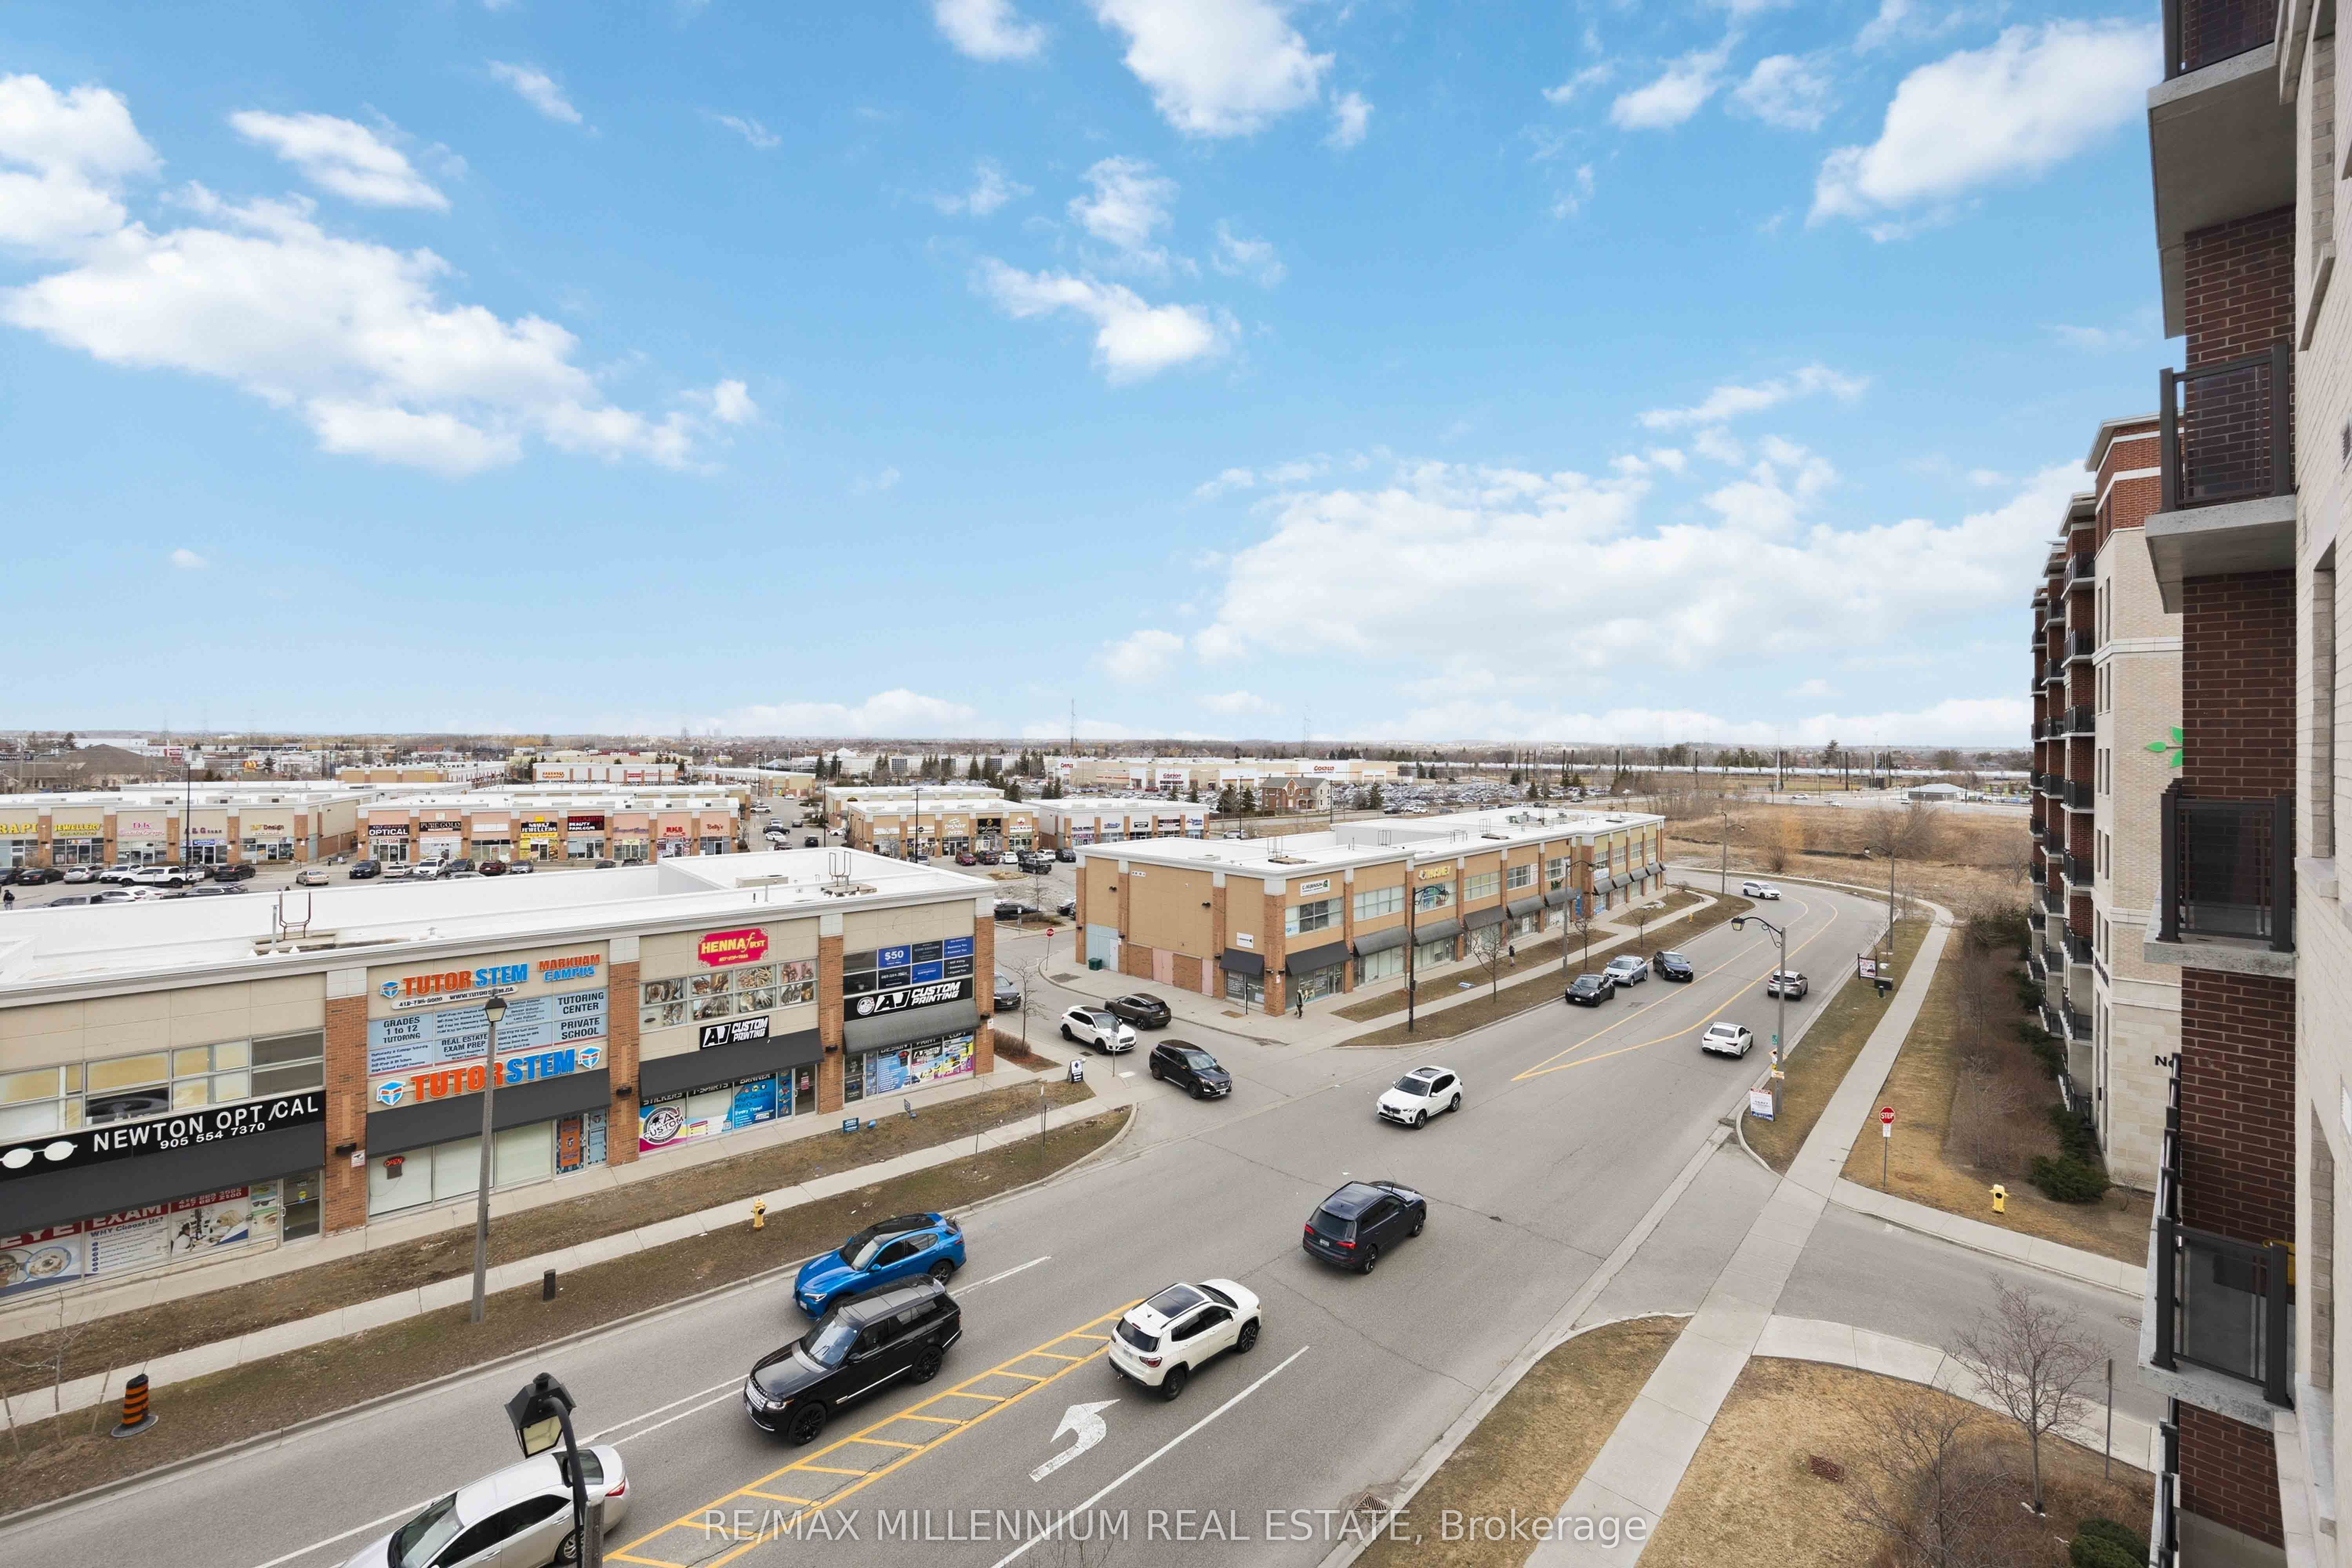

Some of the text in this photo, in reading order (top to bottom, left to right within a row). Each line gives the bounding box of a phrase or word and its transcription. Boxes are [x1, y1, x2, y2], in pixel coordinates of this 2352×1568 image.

[701, 938, 745, 954] HENNA
[539, 954, 600, 971] MARKHAM
[884, 950, 904, 960] $50
[544, 965, 595, 982] CAMPUS
[557, 992, 604, 1005] TUTORING
[875, 981, 961, 1012] AJ CUSTOM
[911, 990, 959, 1006] PRINTING
[563, 1002, 599, 1014] CENTER
[383, 1016, 420, 1027] GRADES
[561, 1017, 600, 1030] PRIVATE
[383, 1033, 420, 1044] TUTORING
[462, 1033, 488, 1042] ESTATE
[561, 1027, 599, 1040] SCHOOL
[703, 1017, 769, 1047] AJ CUSTOM
[733, 1028, 766, 1042] PRINTING
[443, 1040, 486, 1053] EXAM PREP
[94, 1096, 318, 1152] NEWTON OPTICAL
[643, 1116, 684, 1140] CUSTOM
[160, 1122, 265, 1149] 905 554 7370
[93, 1205, 162, 1228] EXAM
[90, 1228, 113, 1238] WHY
[116, 1221, 147, 1232] Choose
